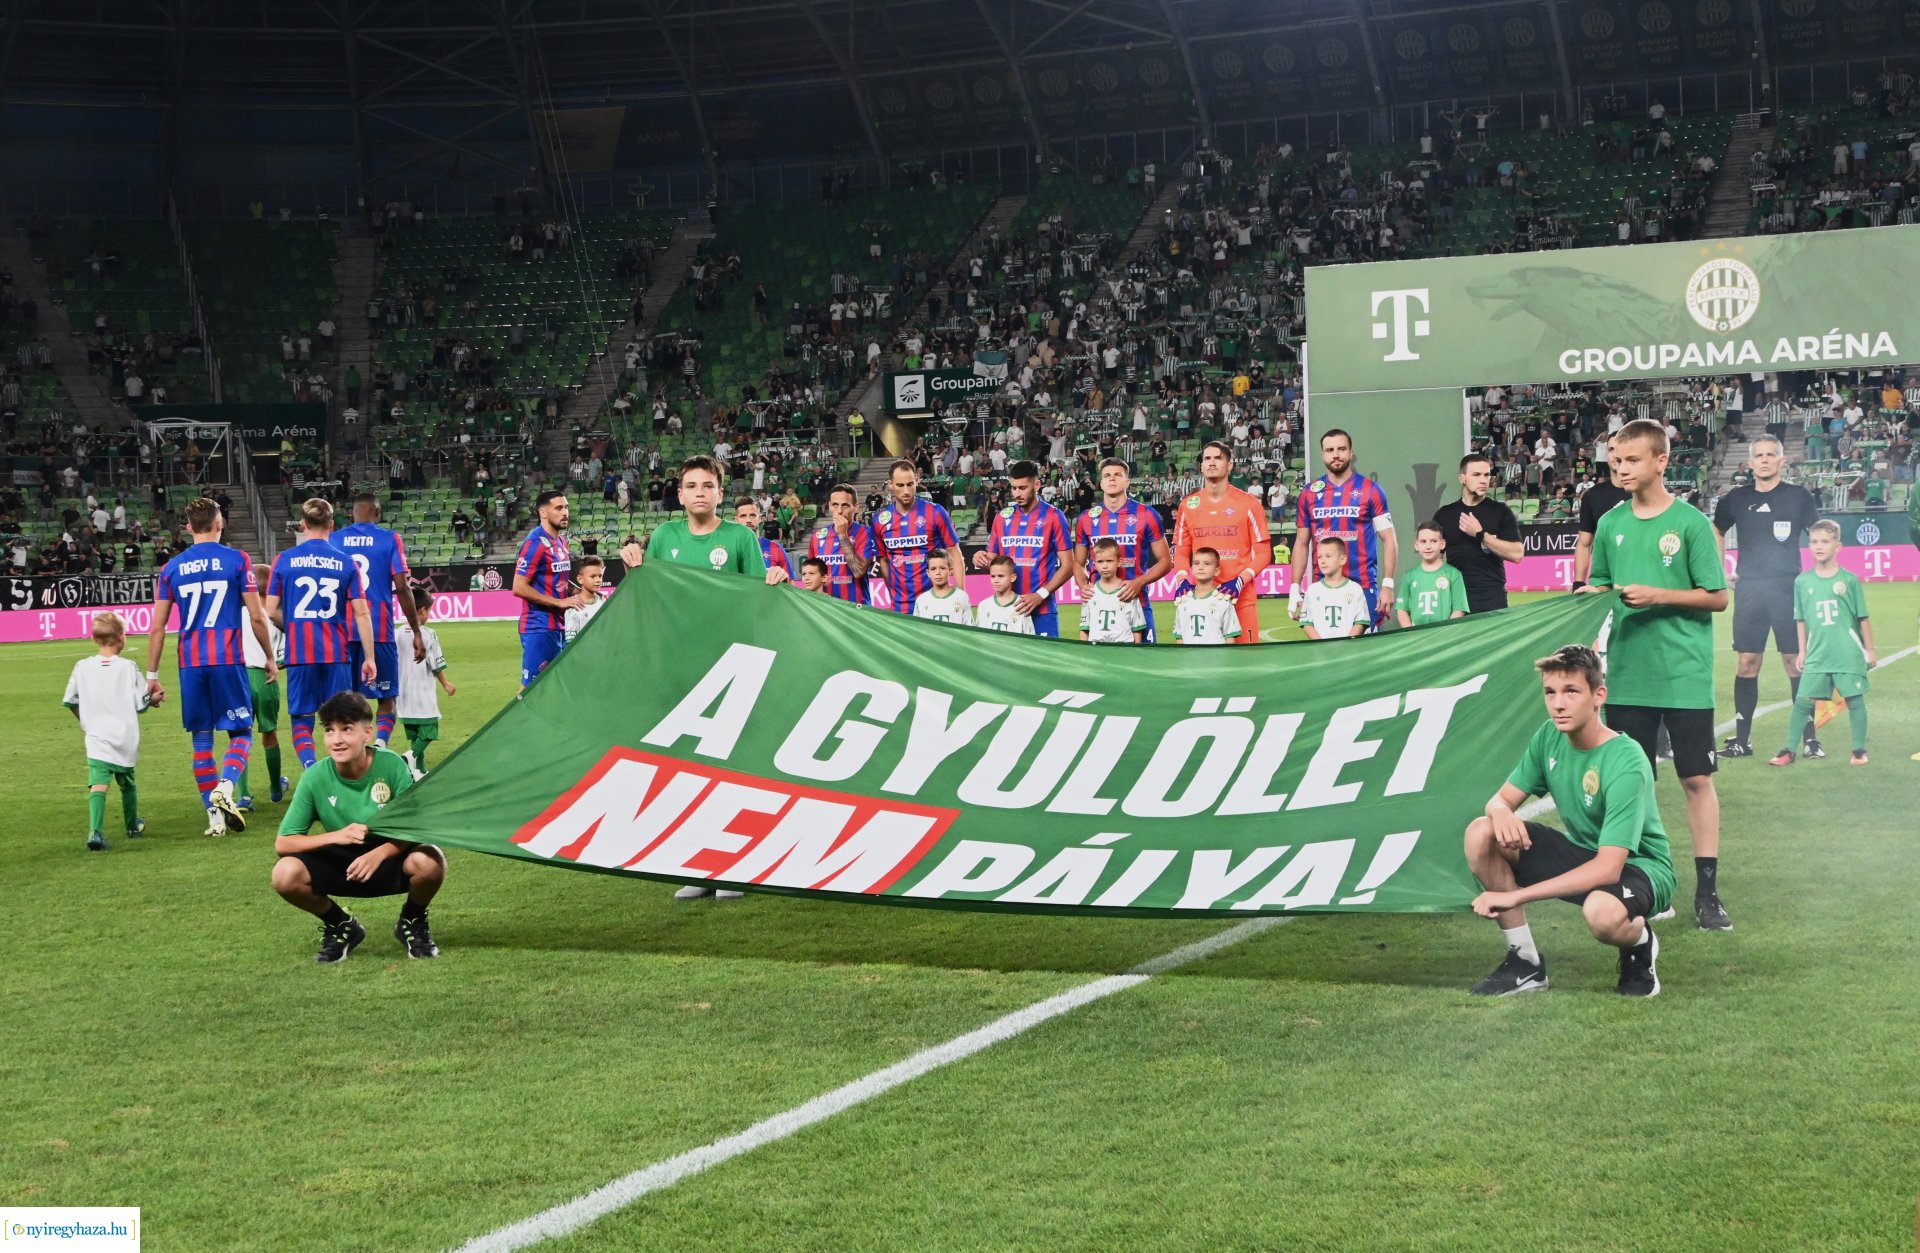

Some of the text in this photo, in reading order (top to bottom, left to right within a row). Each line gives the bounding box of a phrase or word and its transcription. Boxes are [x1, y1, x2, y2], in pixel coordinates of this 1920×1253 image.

[1558, 327, 1898, 375] GROUPAMA ARÉNA
[271, 425, 317, 437] Aréna
[343, 536, 374, 547] KEITA
[179, 557, 223, 576] NAGY B.
[178, 580, 229, 631] 77
[294, 576, 340, 619] 23
[640, 642, 1489, 818] A GYŰLÖLET
[517, 757, 938, 895] NEM
